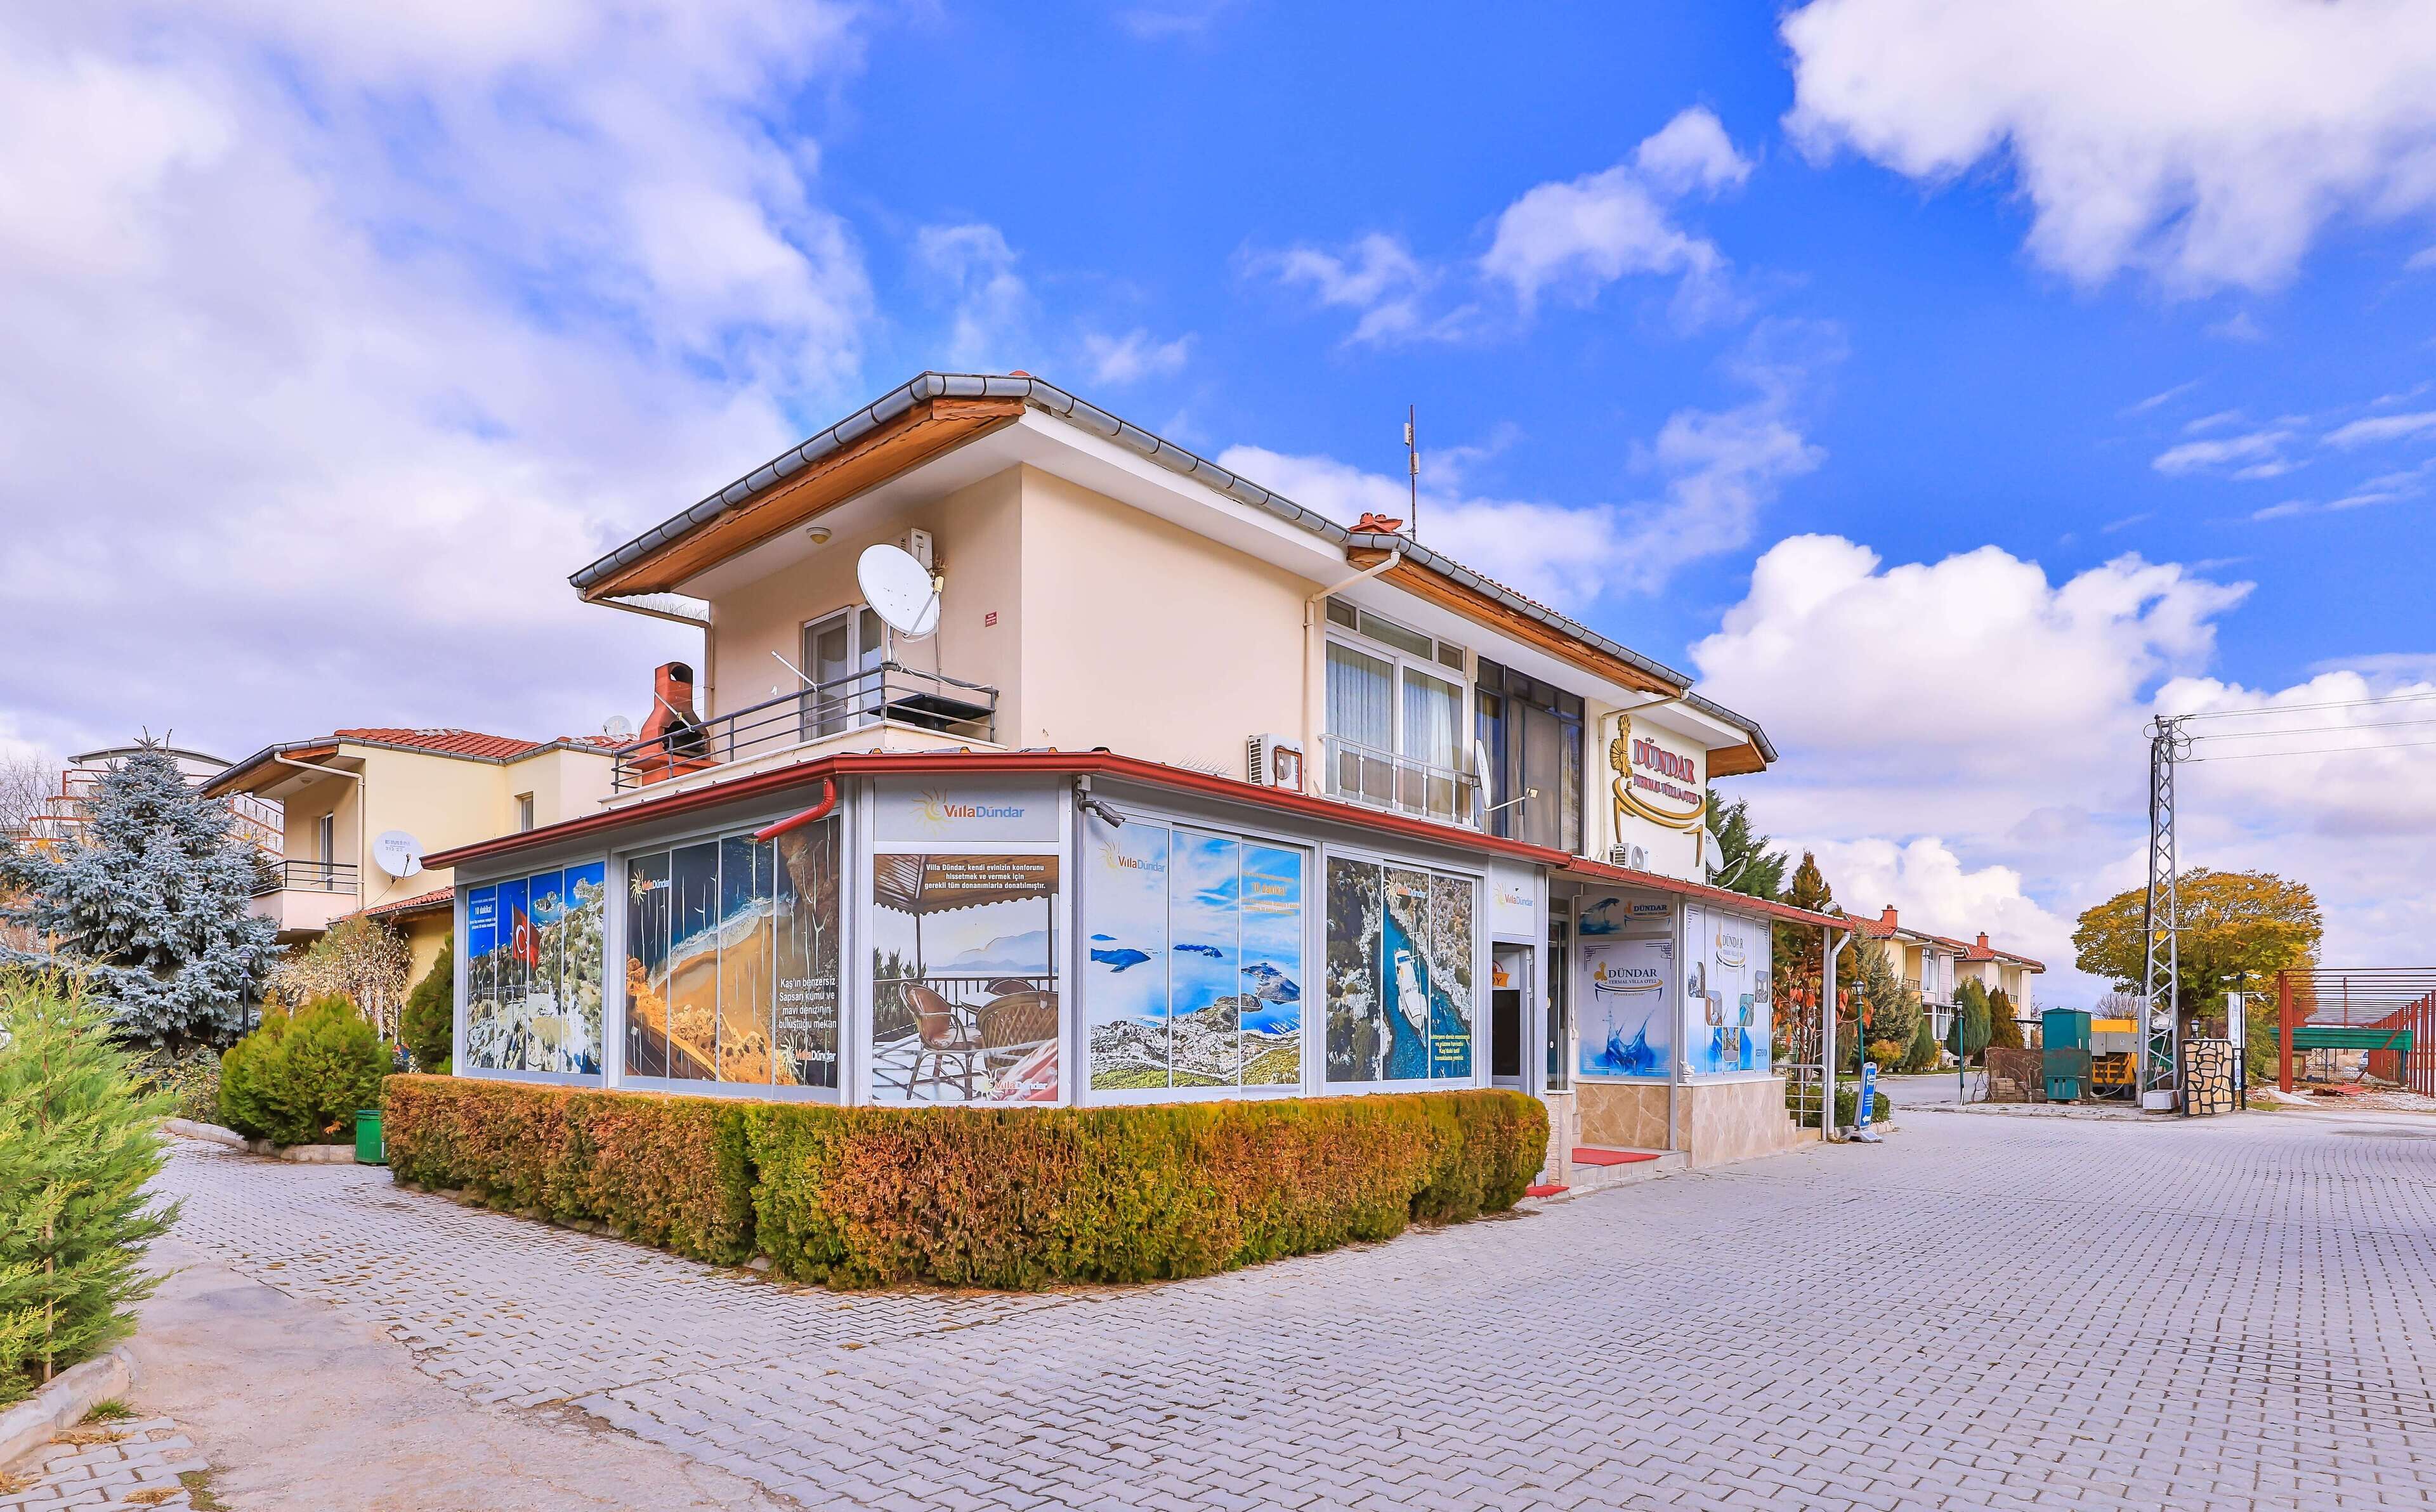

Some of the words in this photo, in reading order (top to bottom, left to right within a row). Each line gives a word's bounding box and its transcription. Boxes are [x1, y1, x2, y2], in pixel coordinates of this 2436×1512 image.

[1633, 738, 1696, 785] DÜNDAR
[1012, 873, 1025, 881] için
[924, 882, 946, 890] gerekli
[1004, 882, 1045, 890] donatılmıştır.
[1608, 968, 1657, 977] DÜNDAR
[780, 978, 801, 989] Kaş'ın
[805, 991, 824, 1000] kumu
[782, 1005, 798, 1015] mavi
[800, 1005, 831, 1015] denizinin
